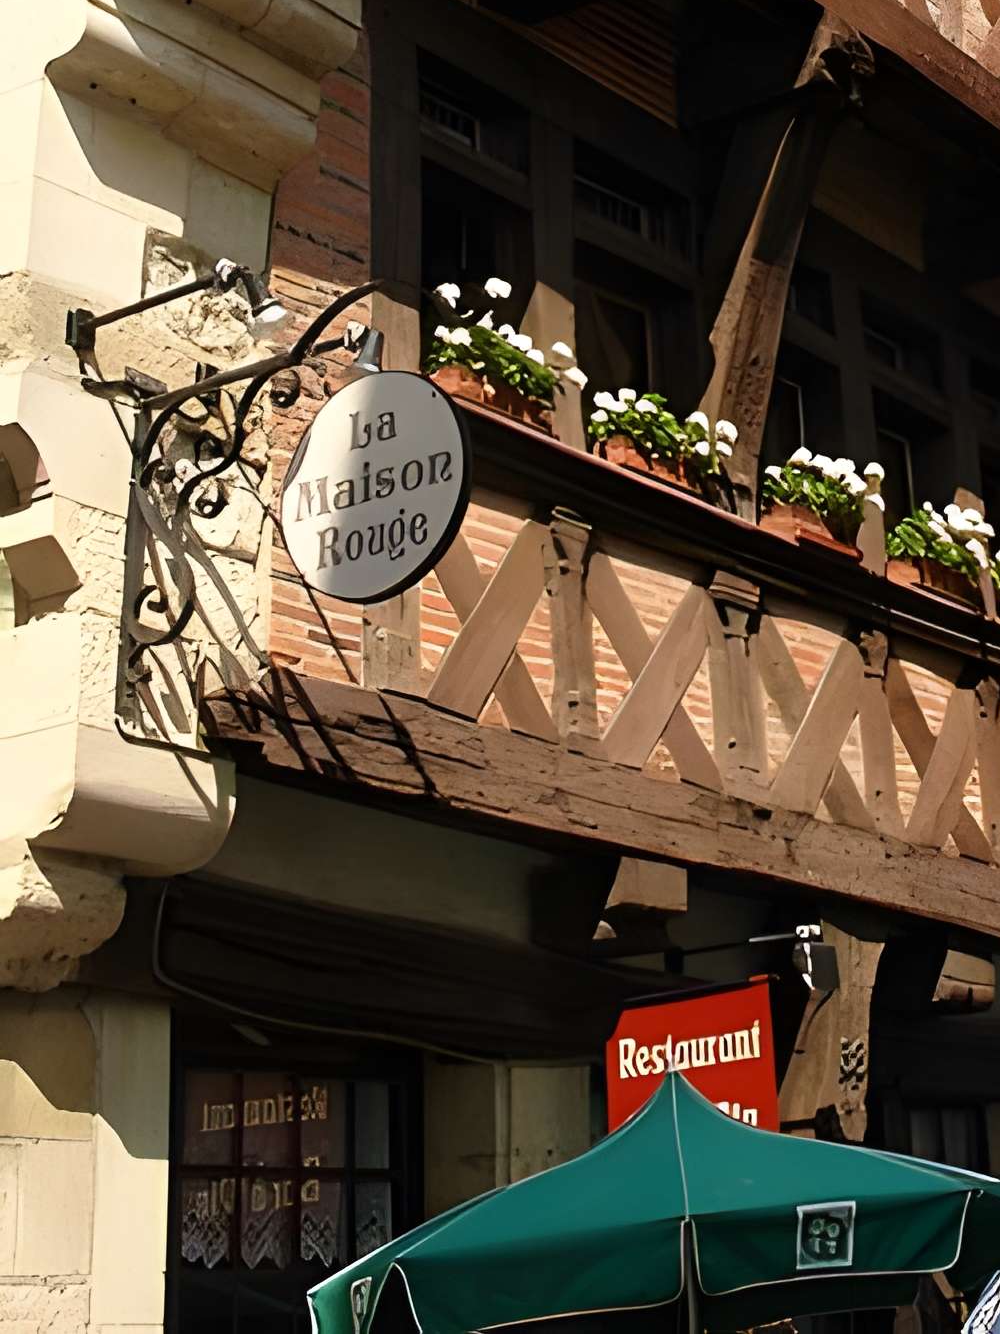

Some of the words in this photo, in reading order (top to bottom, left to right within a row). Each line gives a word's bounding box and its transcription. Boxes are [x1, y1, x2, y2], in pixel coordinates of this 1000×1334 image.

[349, 410, 397, 451] La
[296, 451, 452, 522] Maison
[316, 507, 429, 571] Rouge
[618, 1018, 762, 1080] Restaurant
